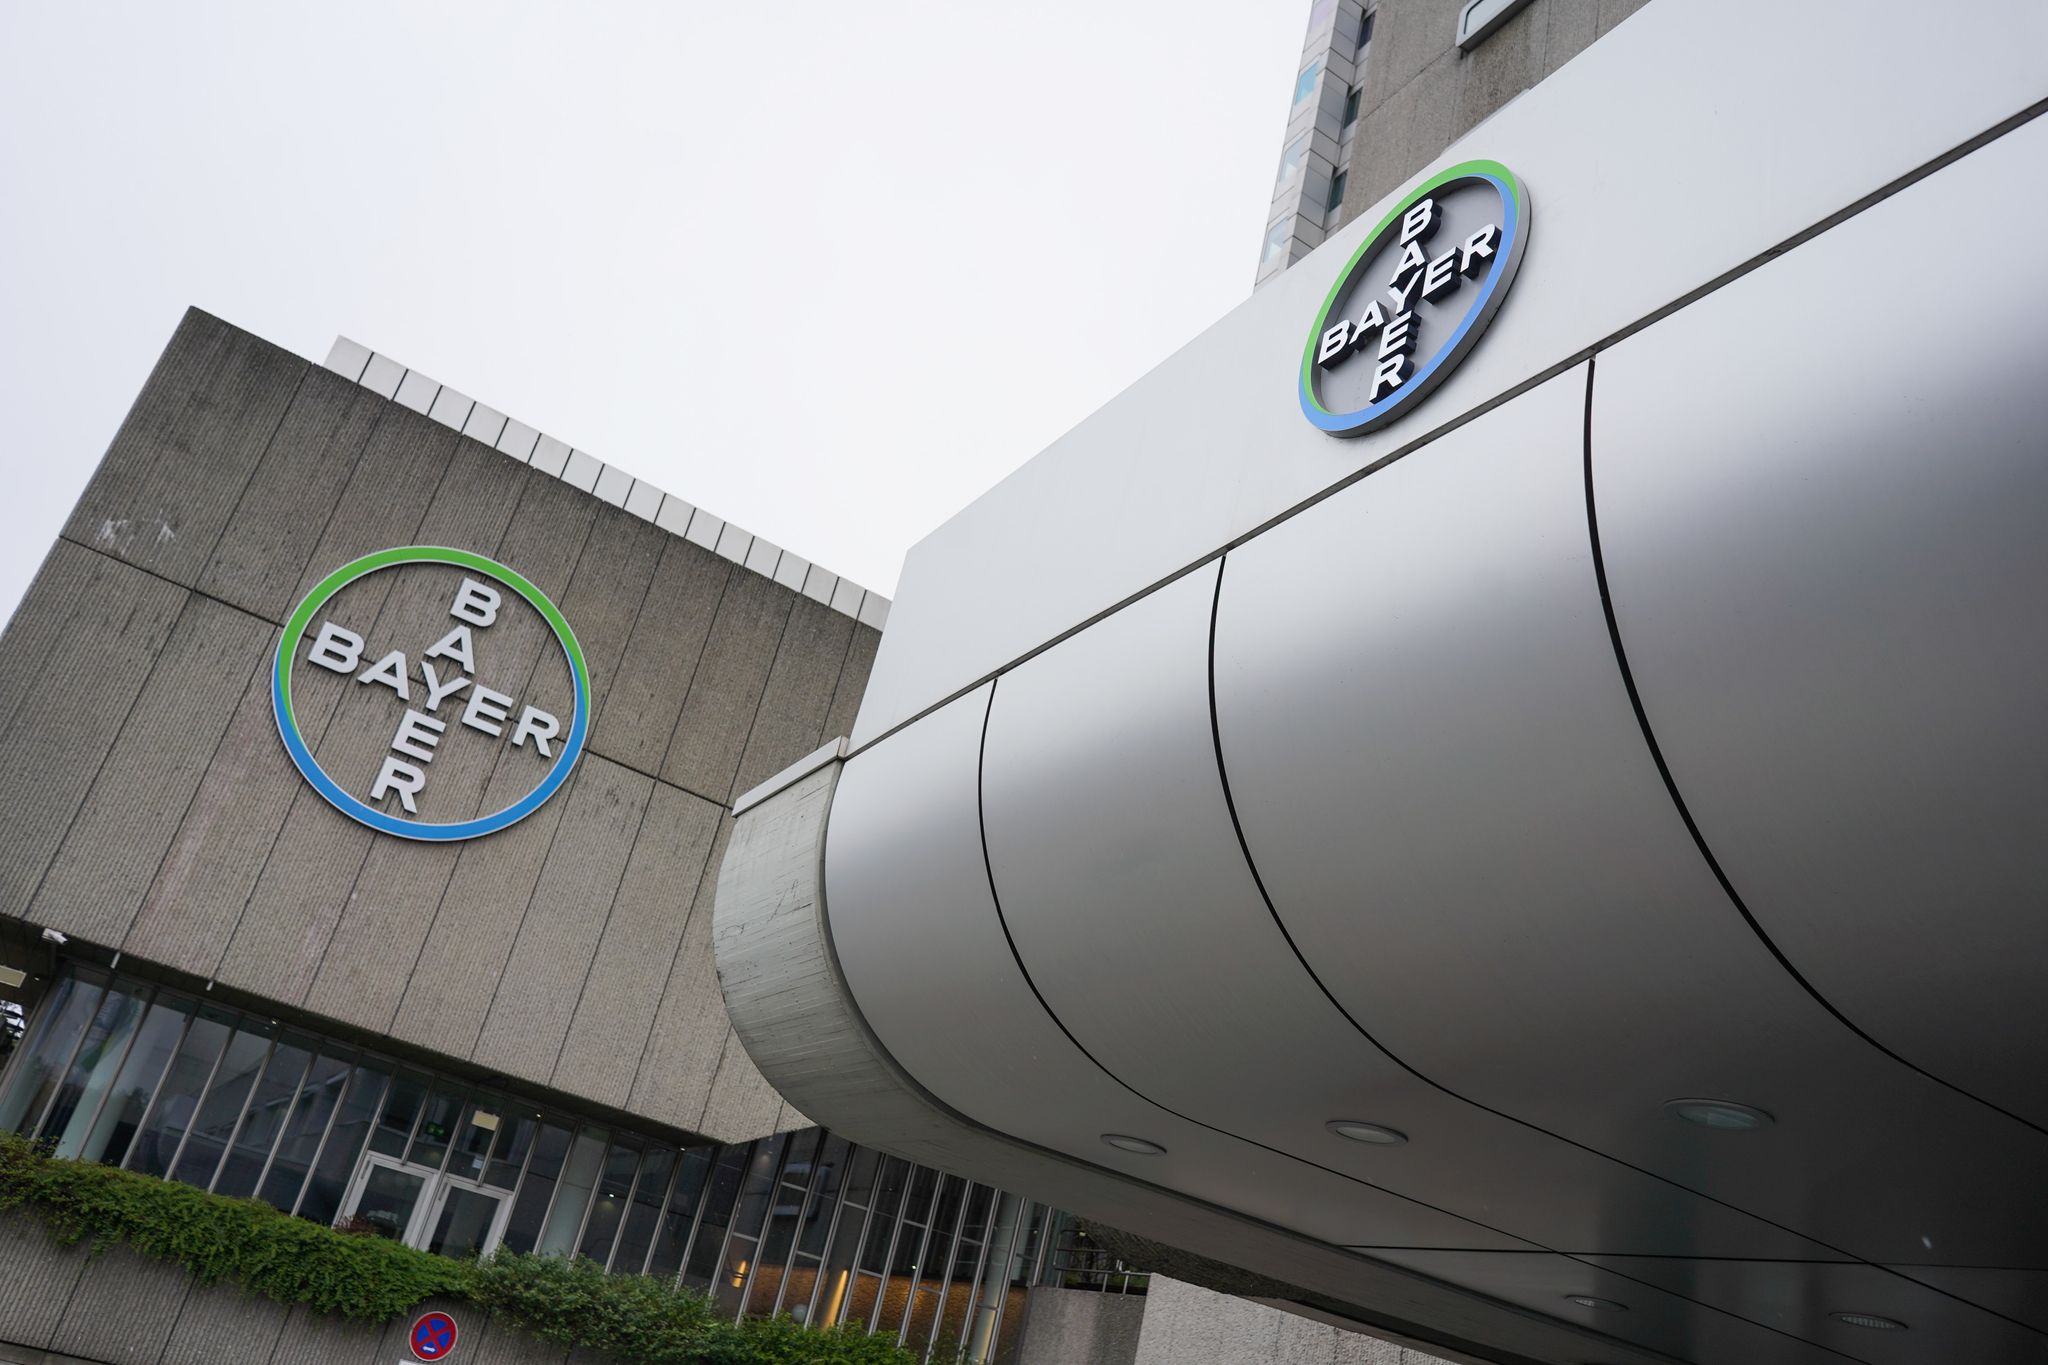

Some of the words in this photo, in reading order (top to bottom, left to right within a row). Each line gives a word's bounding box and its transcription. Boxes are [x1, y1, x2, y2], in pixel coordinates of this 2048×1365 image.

[1317, 224, 1496, 364] BAYER
[1369, 199, 1433, 401] BAYER
[308, 621, 560, 757] BAYER
[370, 577, 501, 813] BAYER
